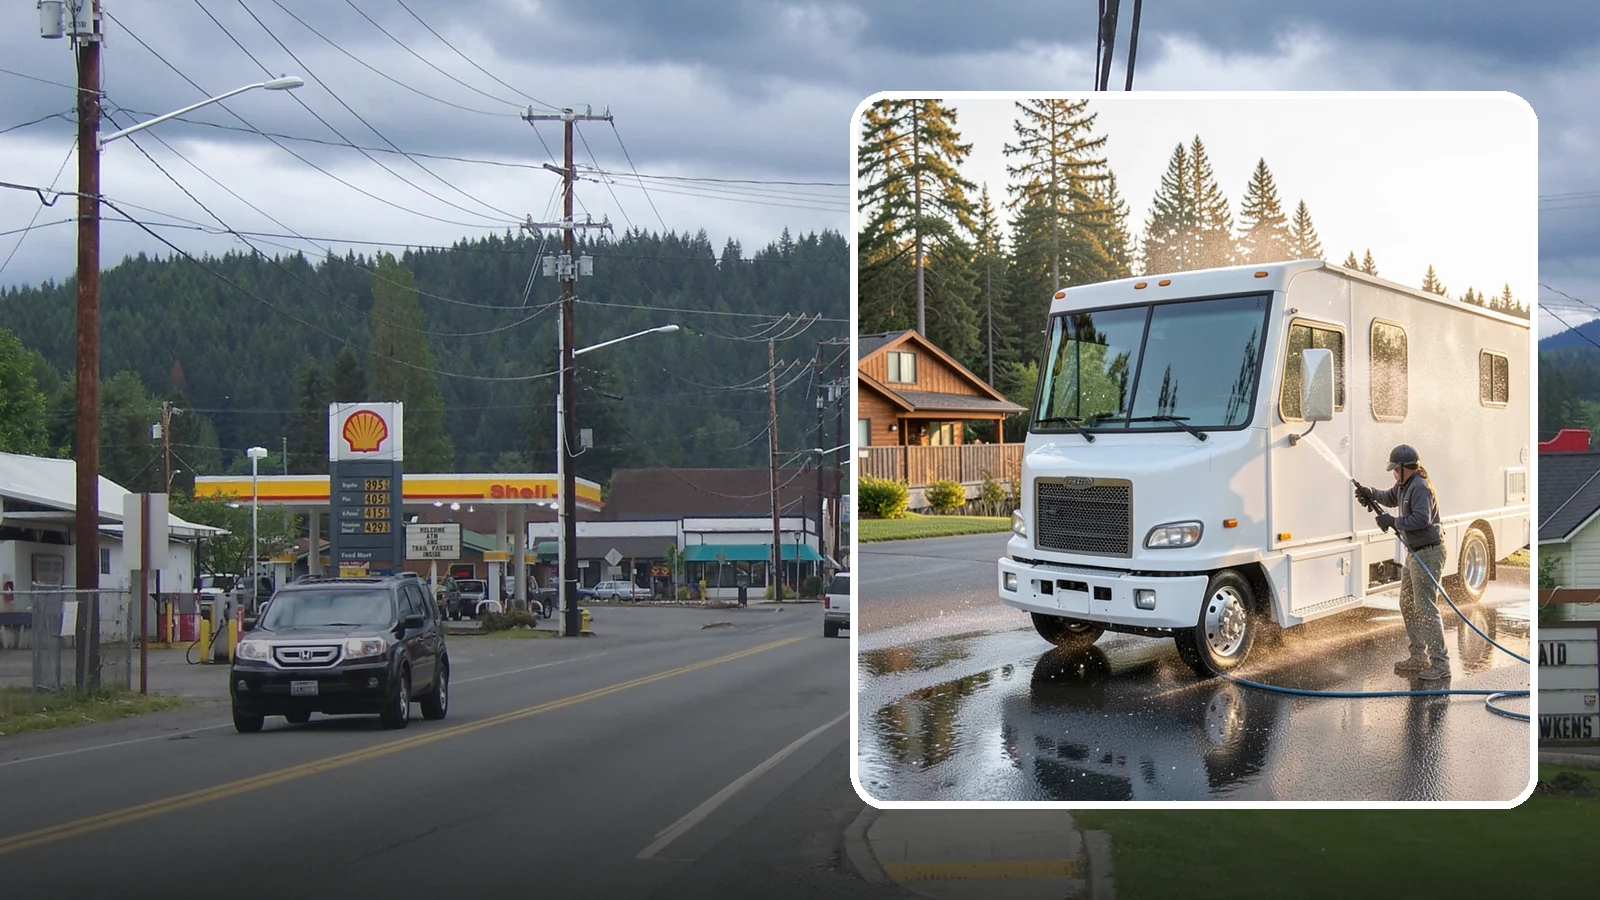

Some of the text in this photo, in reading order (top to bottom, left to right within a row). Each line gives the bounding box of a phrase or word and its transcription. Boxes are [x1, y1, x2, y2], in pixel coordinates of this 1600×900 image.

[366, 480, 383, 490] 395
[490, 484, 547, 499] Shell
[366, 494, 383, 504] 405
[366, 507, 383, 518] 415
[366, 522, 384, 532] 429
